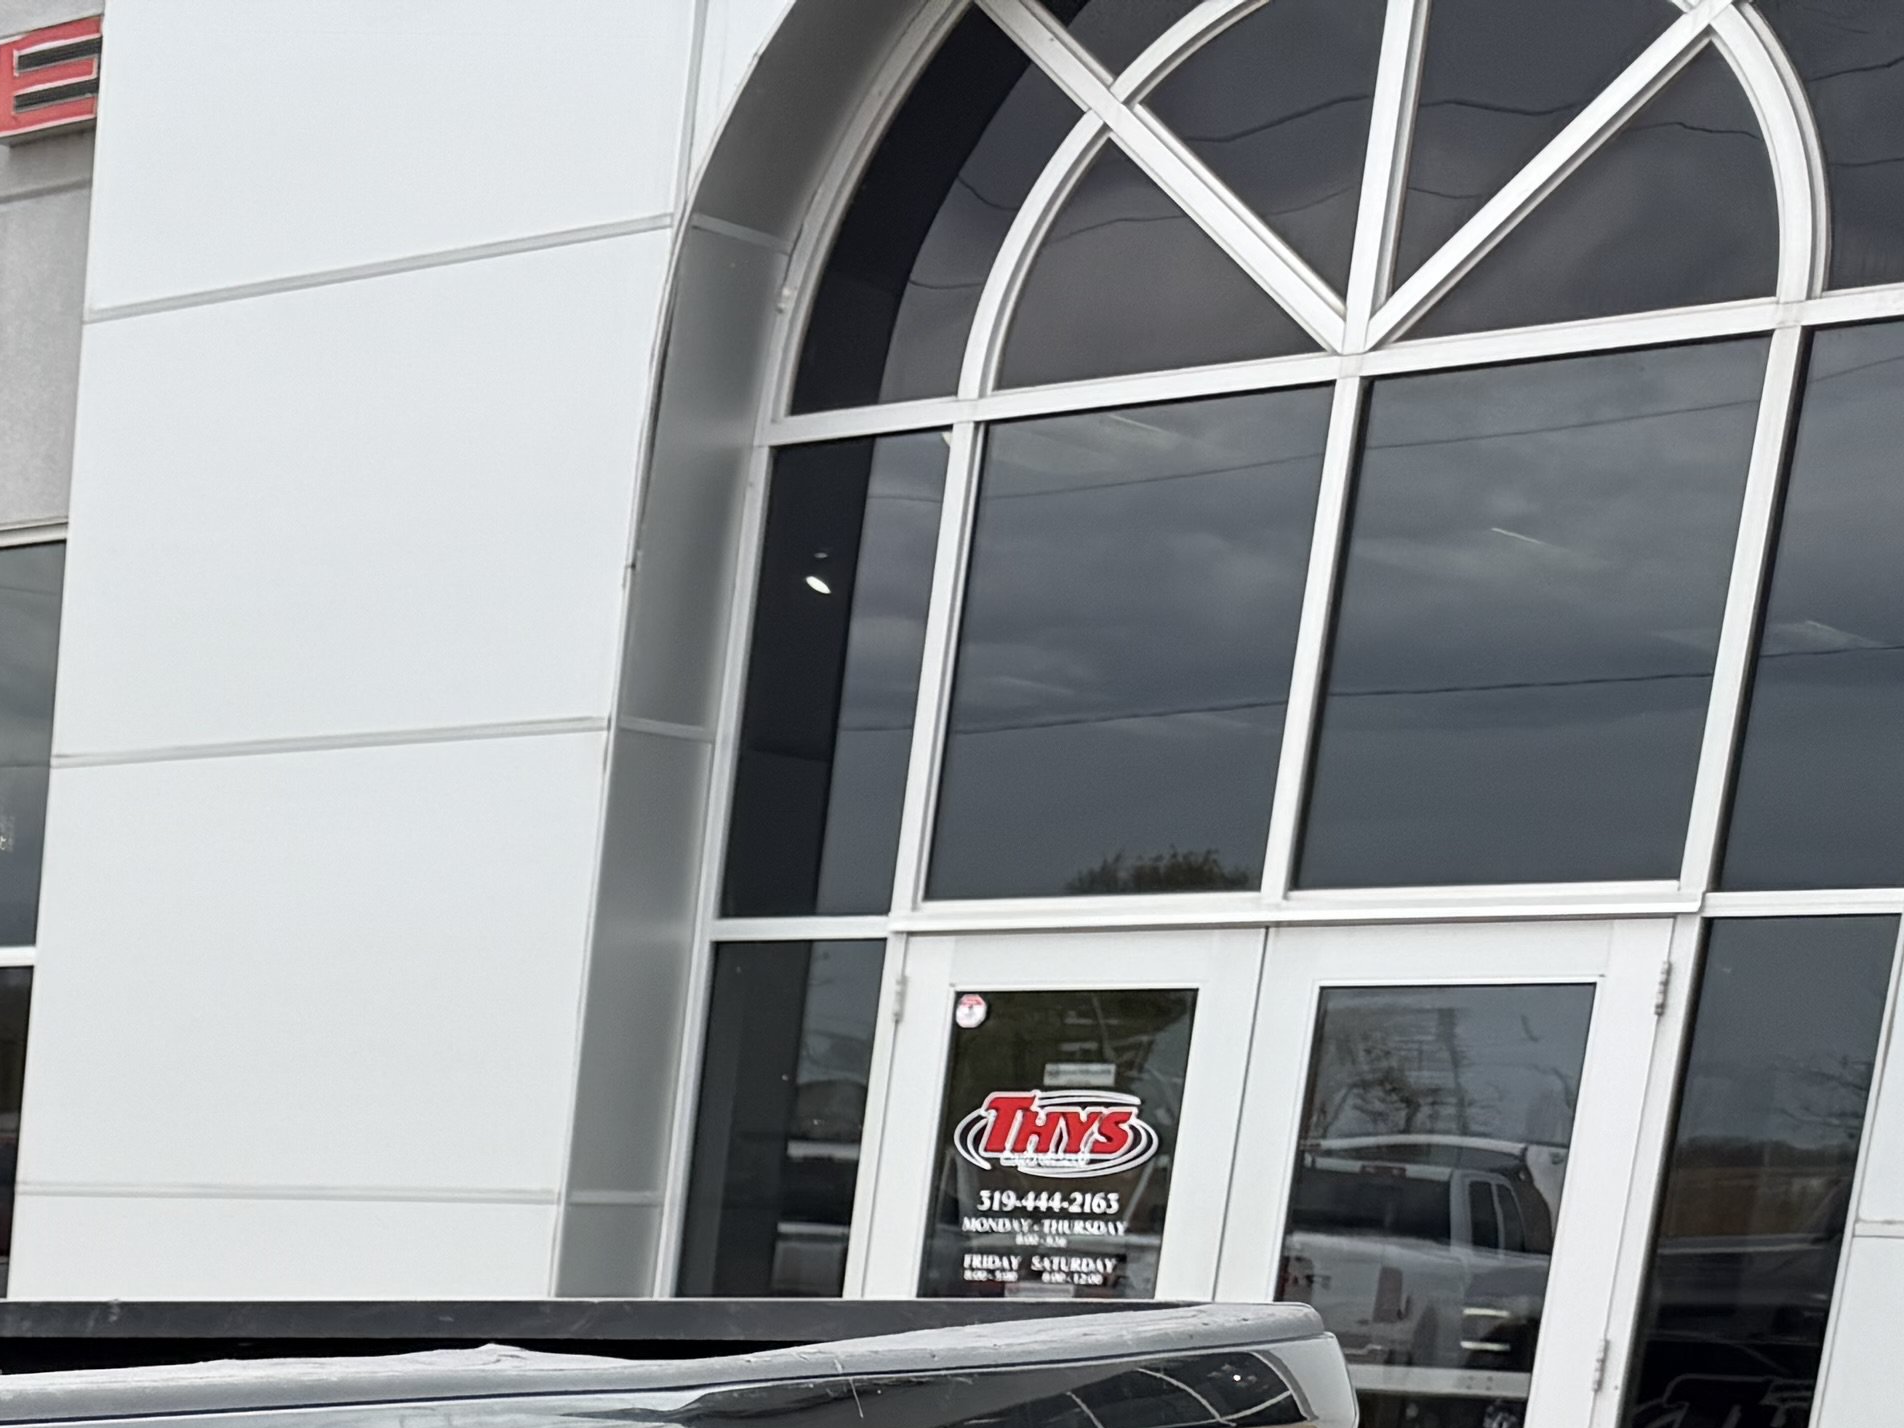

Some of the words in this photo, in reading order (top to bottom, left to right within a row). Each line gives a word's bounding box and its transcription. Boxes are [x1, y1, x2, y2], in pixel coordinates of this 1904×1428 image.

[982, 1094, 1135, 1156] THYS
[962, 1216, 1032, 1233] MONDAY
[1042, 1219, 1127, 1236] THURSDAY
[963, 1253, 1021, 1271] FRIDAY
[1031, 1255, 1116, 1273] SATURDAY
